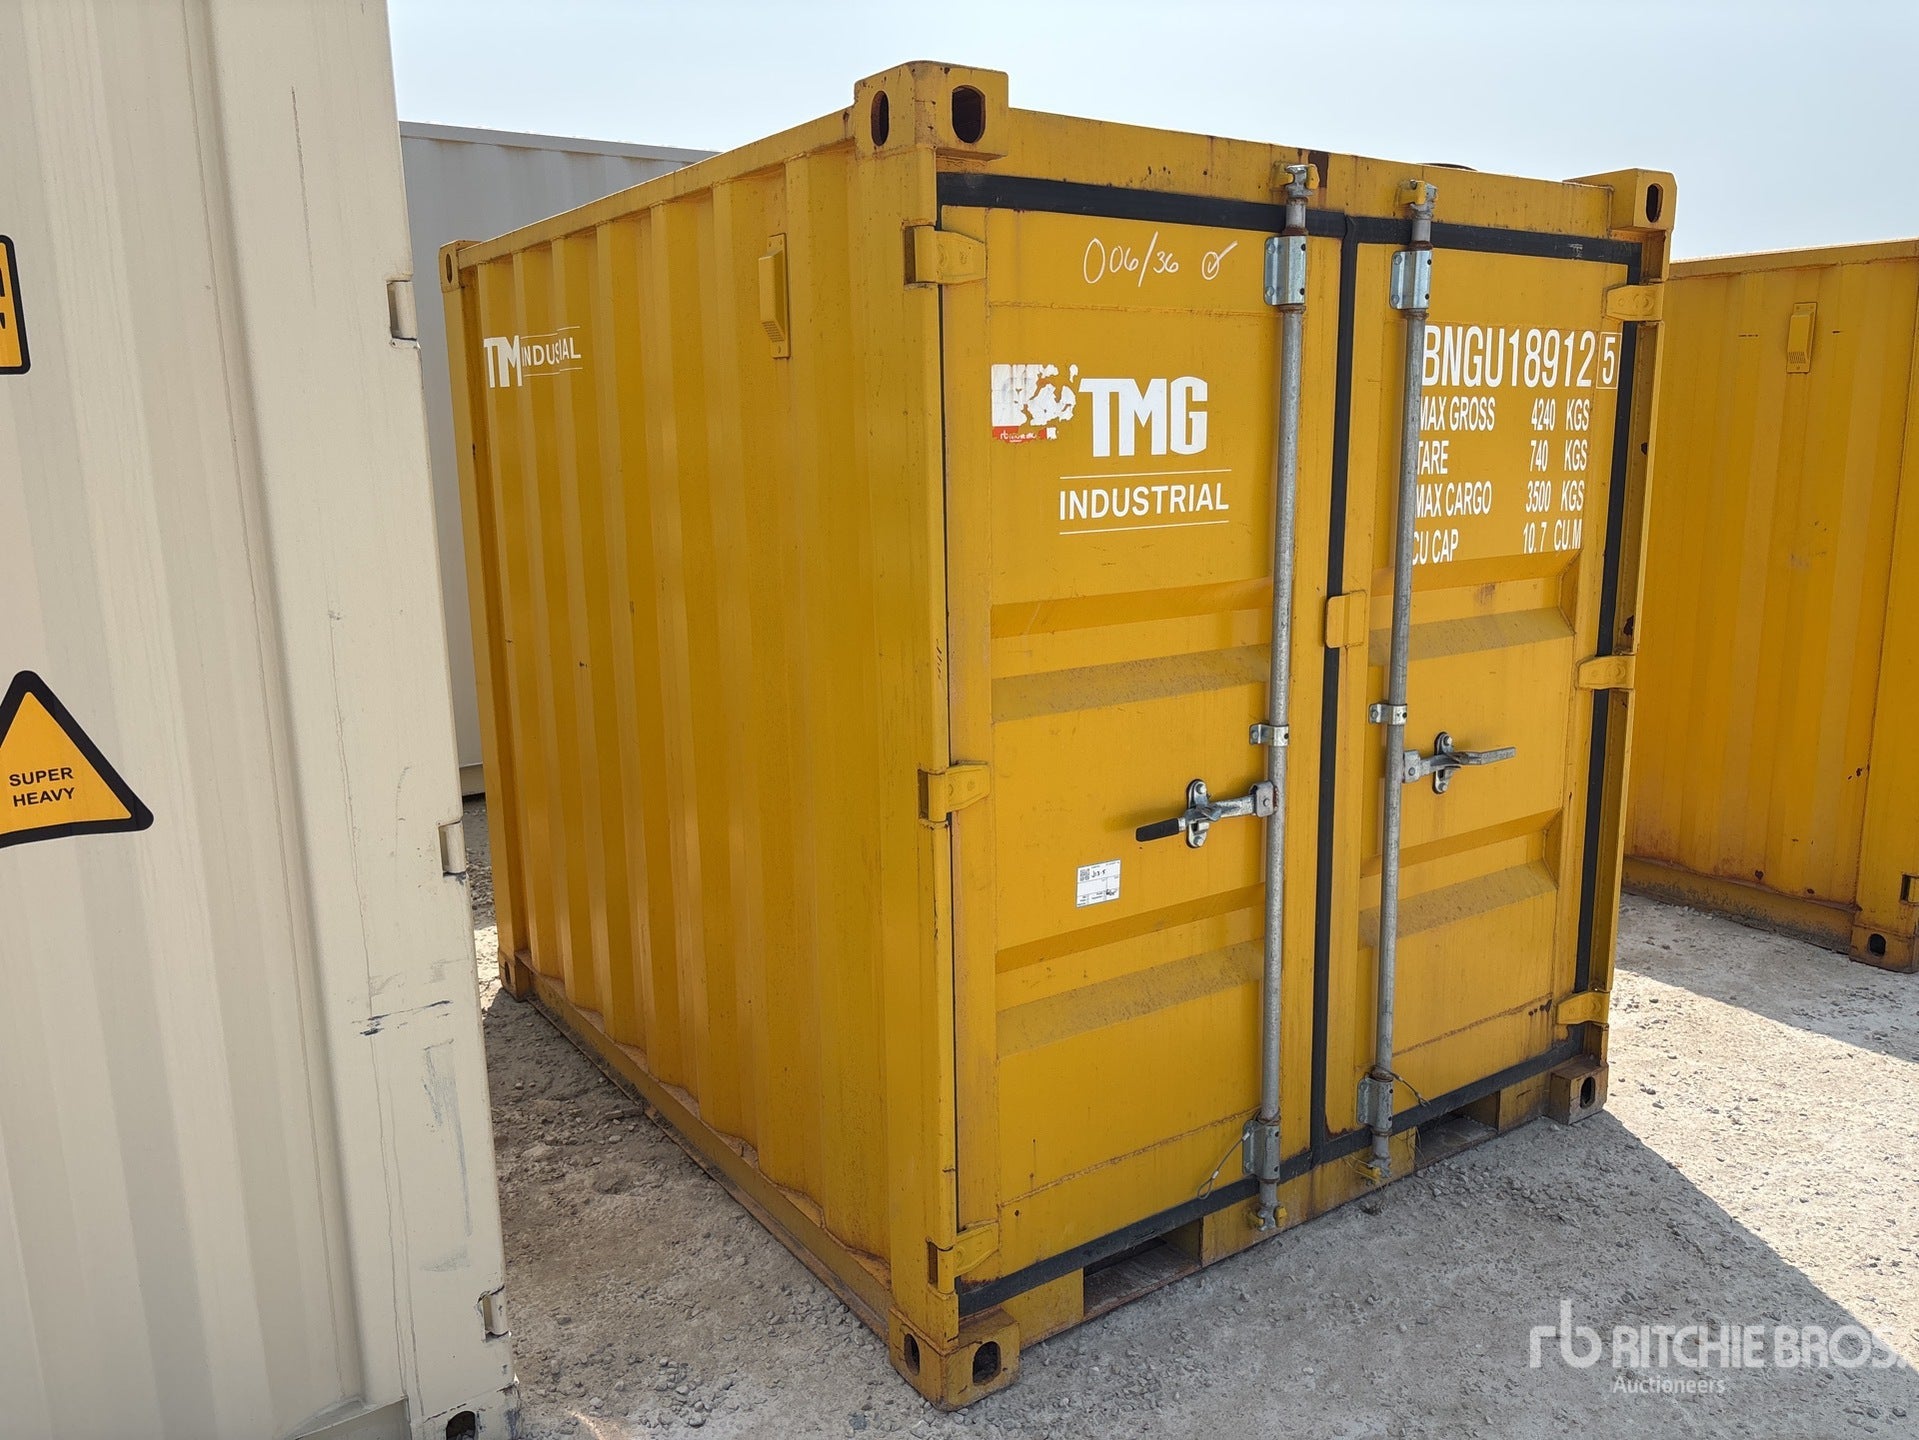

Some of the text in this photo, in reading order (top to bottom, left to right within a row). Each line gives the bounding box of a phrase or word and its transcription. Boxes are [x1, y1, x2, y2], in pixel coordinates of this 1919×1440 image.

[483, 334, 523, 388] TM
[1602, 336, 1616, 384] 5
[1078, 376, 1208, 457] TMG
[1449, 396, 1496, 431] GROSS
[1531, 398, 1591, 431] 4240 KGS
[1530, 439, 1588, 472] 740 KGS
[1059, 482, 1230, 520] INDUSTRIAL
[1445, 480, 1492, 517] CARGO
[1525, 479, 1586, 513] 3500 KGS
[1431, 528, 1459, 564] CAP
[1553, 518, 1582, 551] CU.M
[9, 767, 74, 787] SUPER
[13, 787, 75, 808] HEAVY
